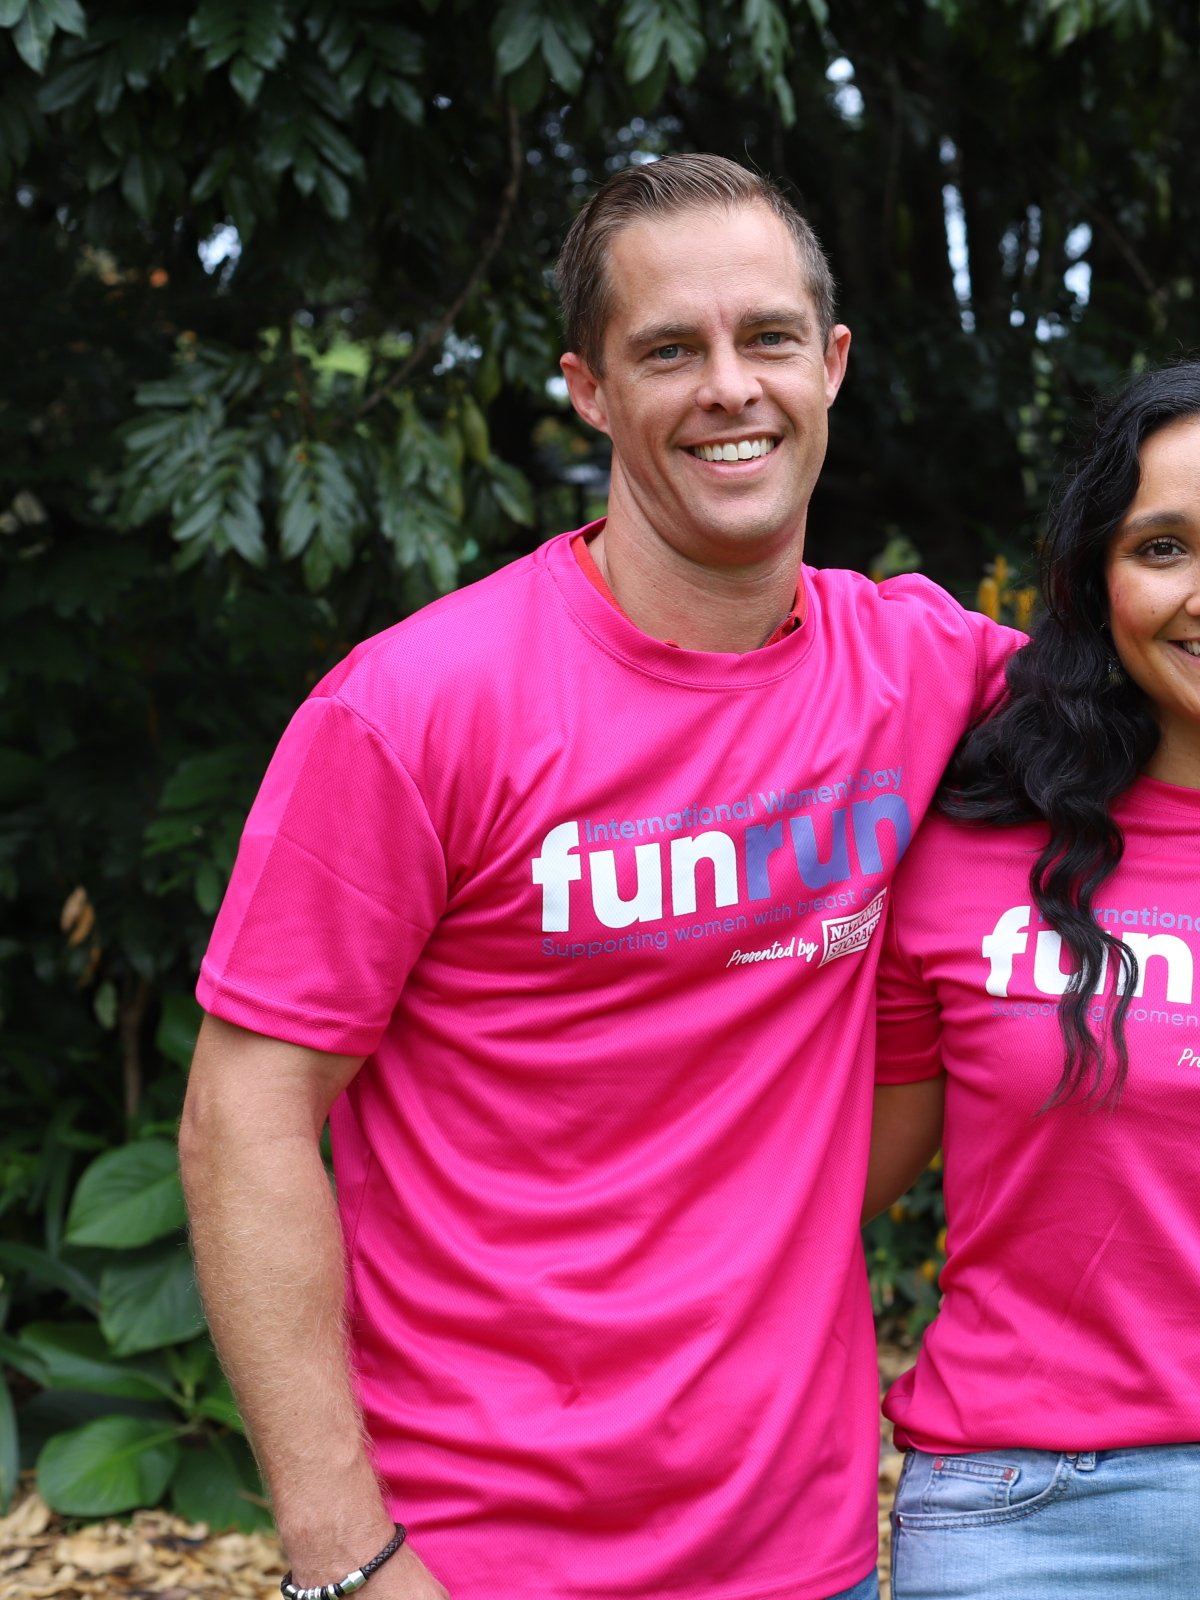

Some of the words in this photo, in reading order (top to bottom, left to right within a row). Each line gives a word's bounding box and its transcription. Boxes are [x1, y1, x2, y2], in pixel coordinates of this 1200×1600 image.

[585, 795, 754, 843] International
[860, 766, 902, 792] Day
[540, 929, 668, 960] Supporting
[675, 915, 748, 942] women
[754, 905, 792, 926] with
[796, 889, 856, 916] breast
[726, 937, 794, 968] Presented
[797, 938, 819, 963] by
